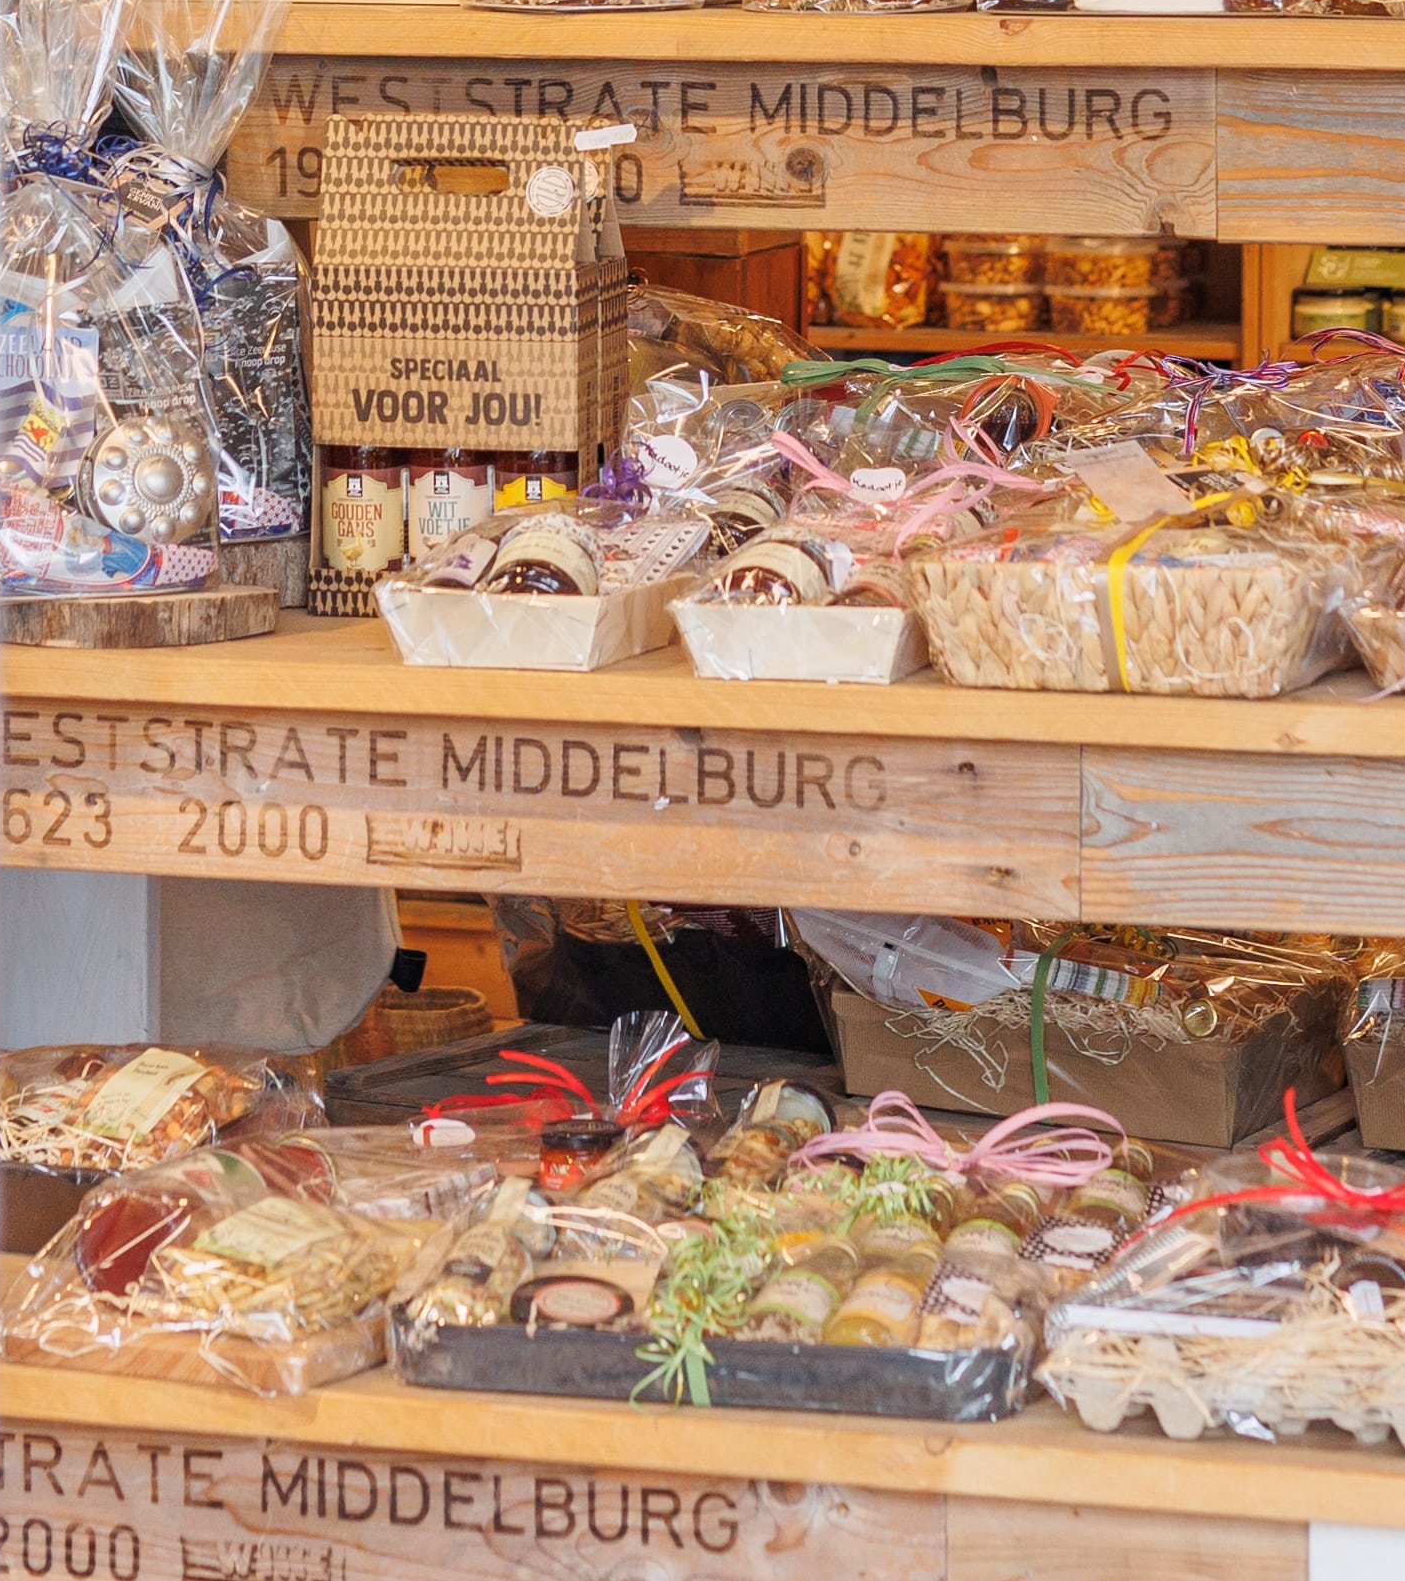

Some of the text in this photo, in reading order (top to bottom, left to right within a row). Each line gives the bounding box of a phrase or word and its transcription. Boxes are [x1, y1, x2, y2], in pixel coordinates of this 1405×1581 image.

[269, 75, 1172, 141] WESTSTRATE MIDDELBURG
[390, 357, 502, 383] SPECIAAL
[171, 393, 197, 408] drop
[351, 388, 542, 427] VOOR JOU!
[331, 501, 382, 521] GOUDEN
[428, 501, 458, 518] WIT
[338, 520, 375, 538] GANS
[3, 710, 887, 812] ESTSTRATE MIDDELBURG
[2, 787, 113, 849] 623
[177, 796, 329, 861] 2000
[260, 1454, 740, 1553] MIDDELBURG
